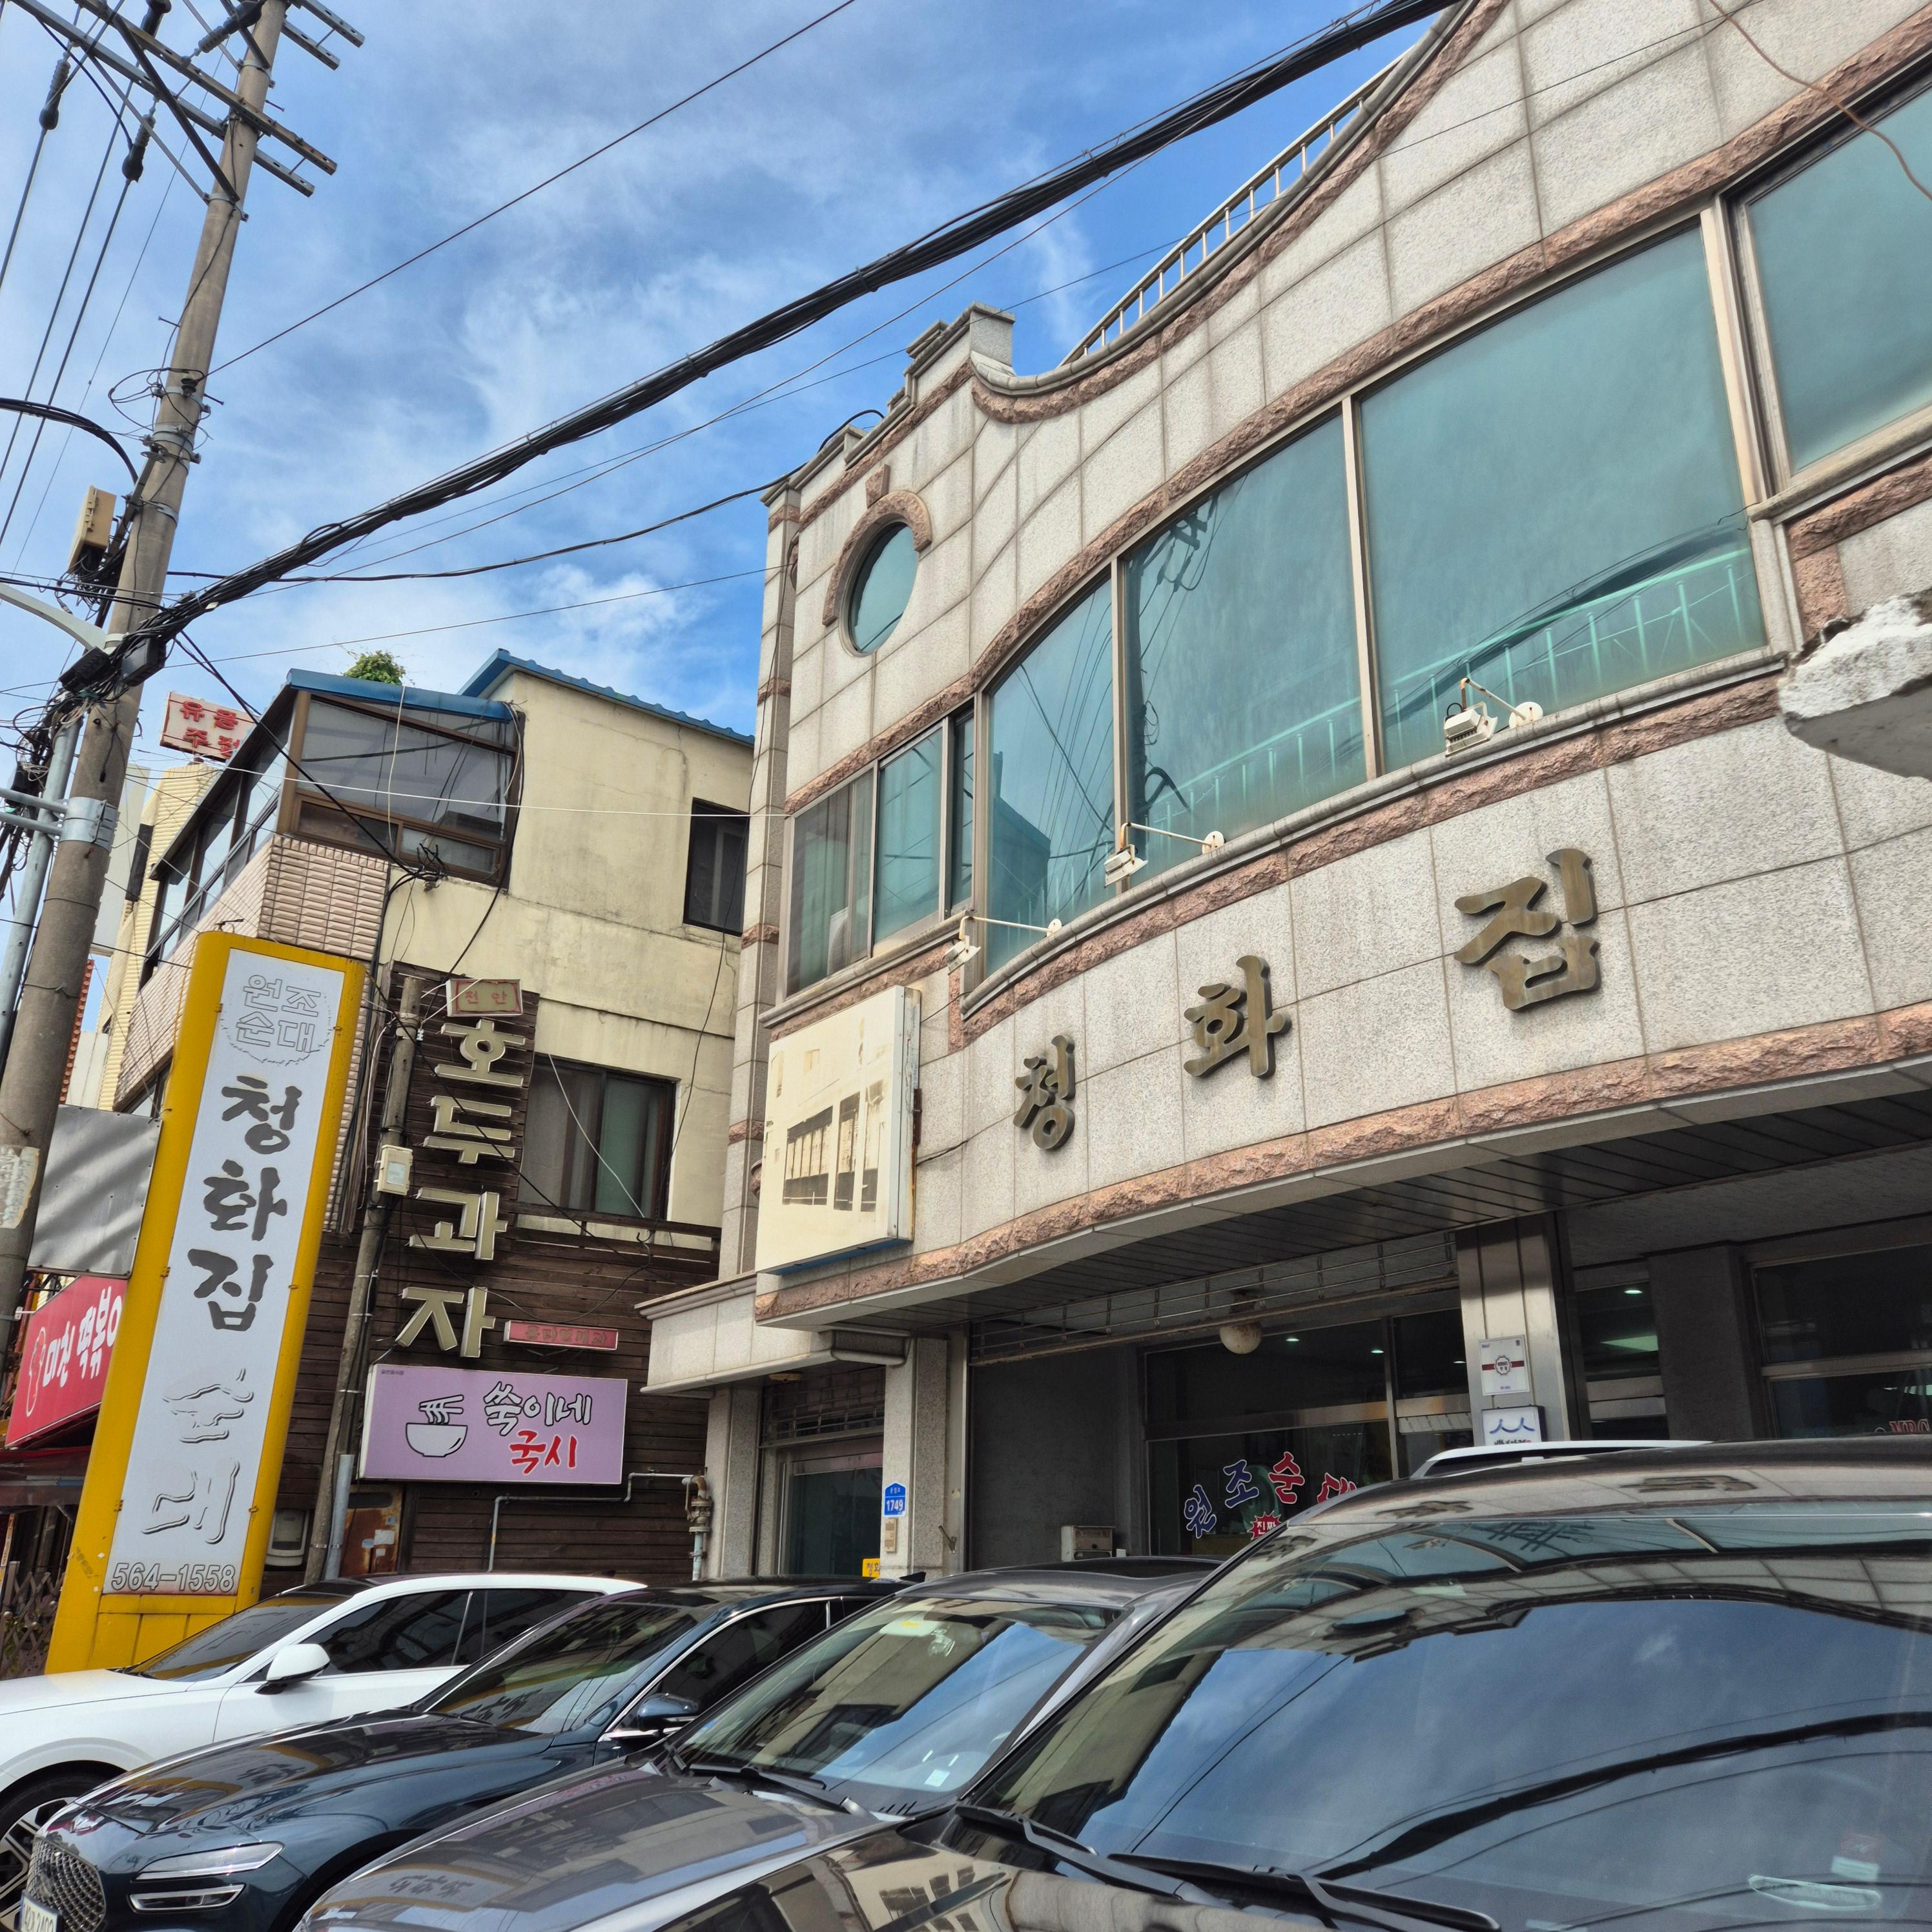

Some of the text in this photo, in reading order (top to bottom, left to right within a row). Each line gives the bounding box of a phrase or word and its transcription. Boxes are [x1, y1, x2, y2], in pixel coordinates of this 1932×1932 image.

[243, 974, 321, 1018] 원조
[1011, 847, 1602, 1151] 청화집
[236, 1011, 315, 1053] 순대
[187, 1074, 302, 1332] 청화집
[395, 1018, 526, 1358] 호두과자
[483, 1381, 593, 1436] 쑥이네
[508, 1429, 579, 1475] 국시
[886, 1499, 903, 1512] 1749
[110, 1561, 236, 1592] 564-1558
